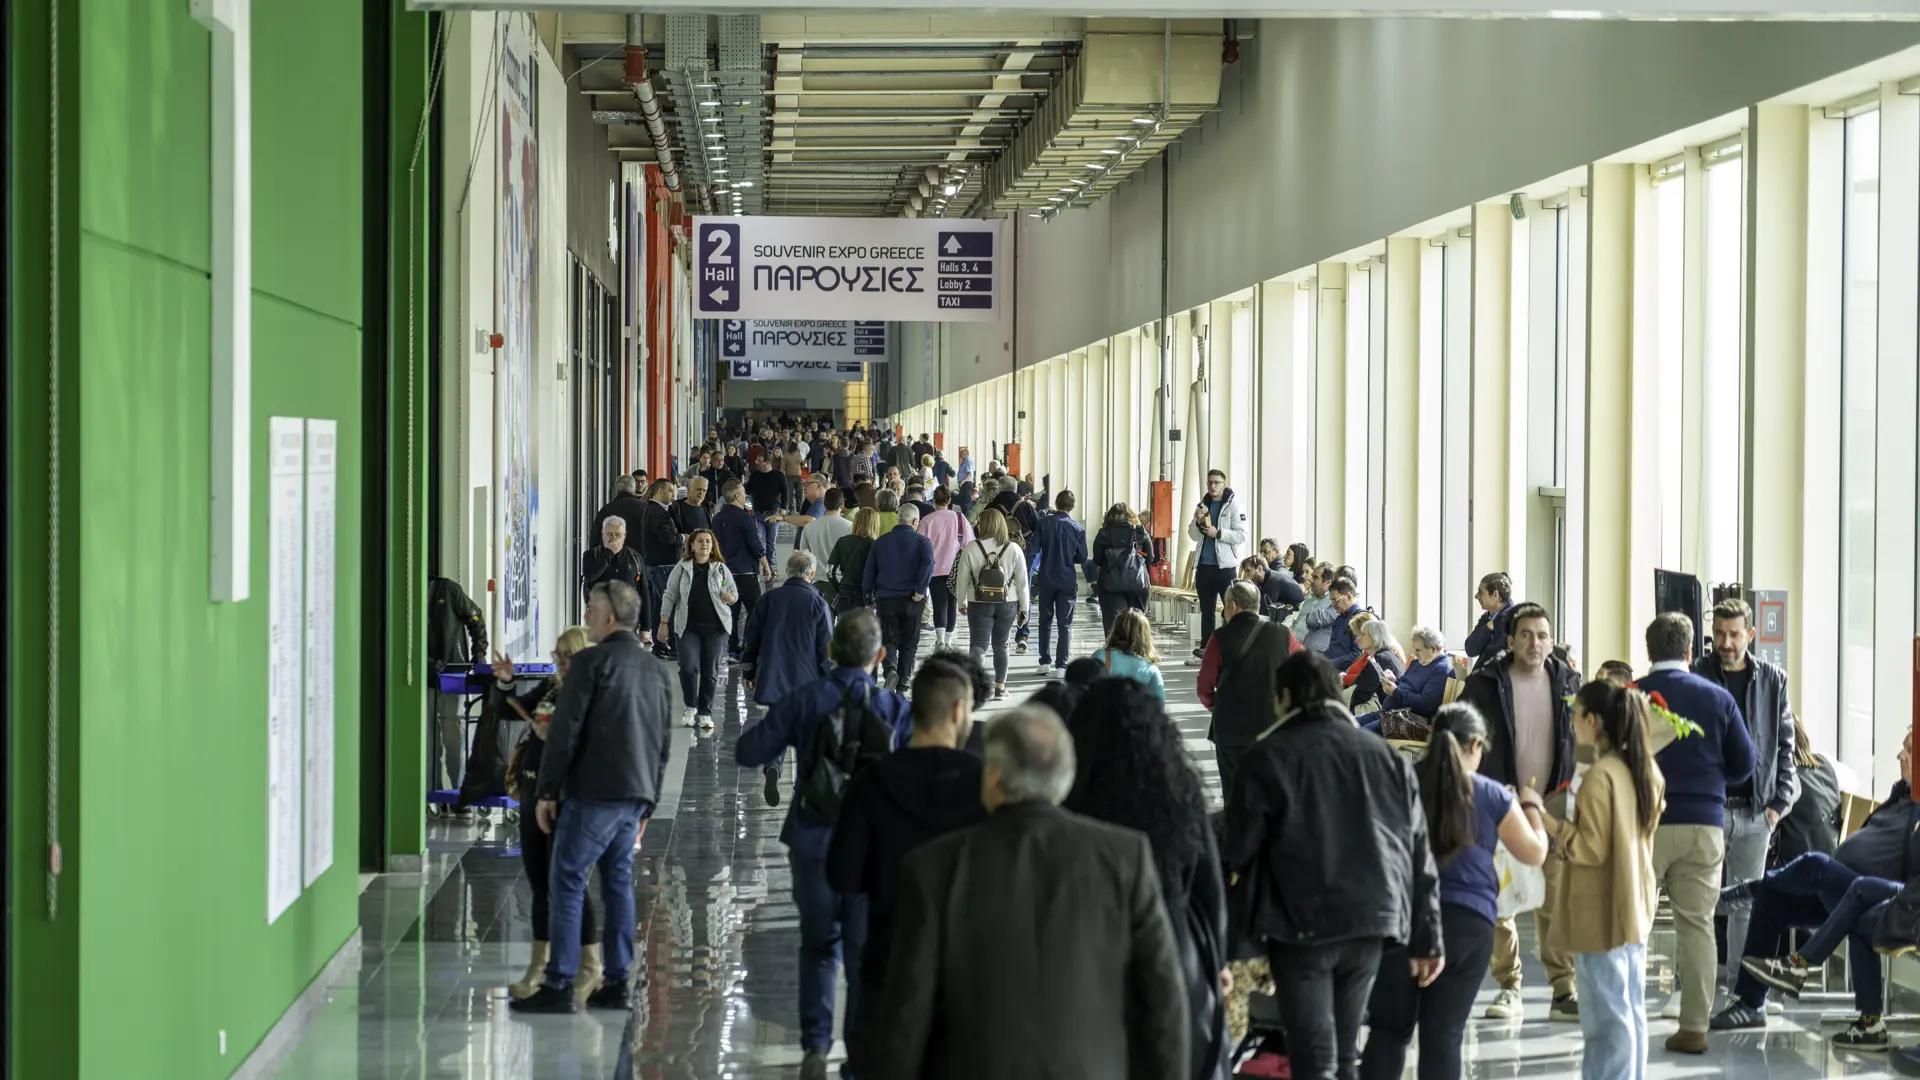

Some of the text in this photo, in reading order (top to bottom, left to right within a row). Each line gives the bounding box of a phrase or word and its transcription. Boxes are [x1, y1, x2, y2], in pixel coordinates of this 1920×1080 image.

[708, 229, 731, 264] 2
[754, 246, 925, 260] SOUVENIR EXPO GREECE
[940, 262, 959, 272] Halls
[972, 263, 979, 272] 4
[705, 267, 735, 282] Hall
[754, 265, 925, 293] ΠΑΡΟΥΣΙΕΣ
[940, 279, 971, 291] Lobby 2
[940, 297, 960, 306] TAXI
[753, 320, 847, 328] SOUVENIR EXPO GREECE
[726, 332, 743, 340] Hall
